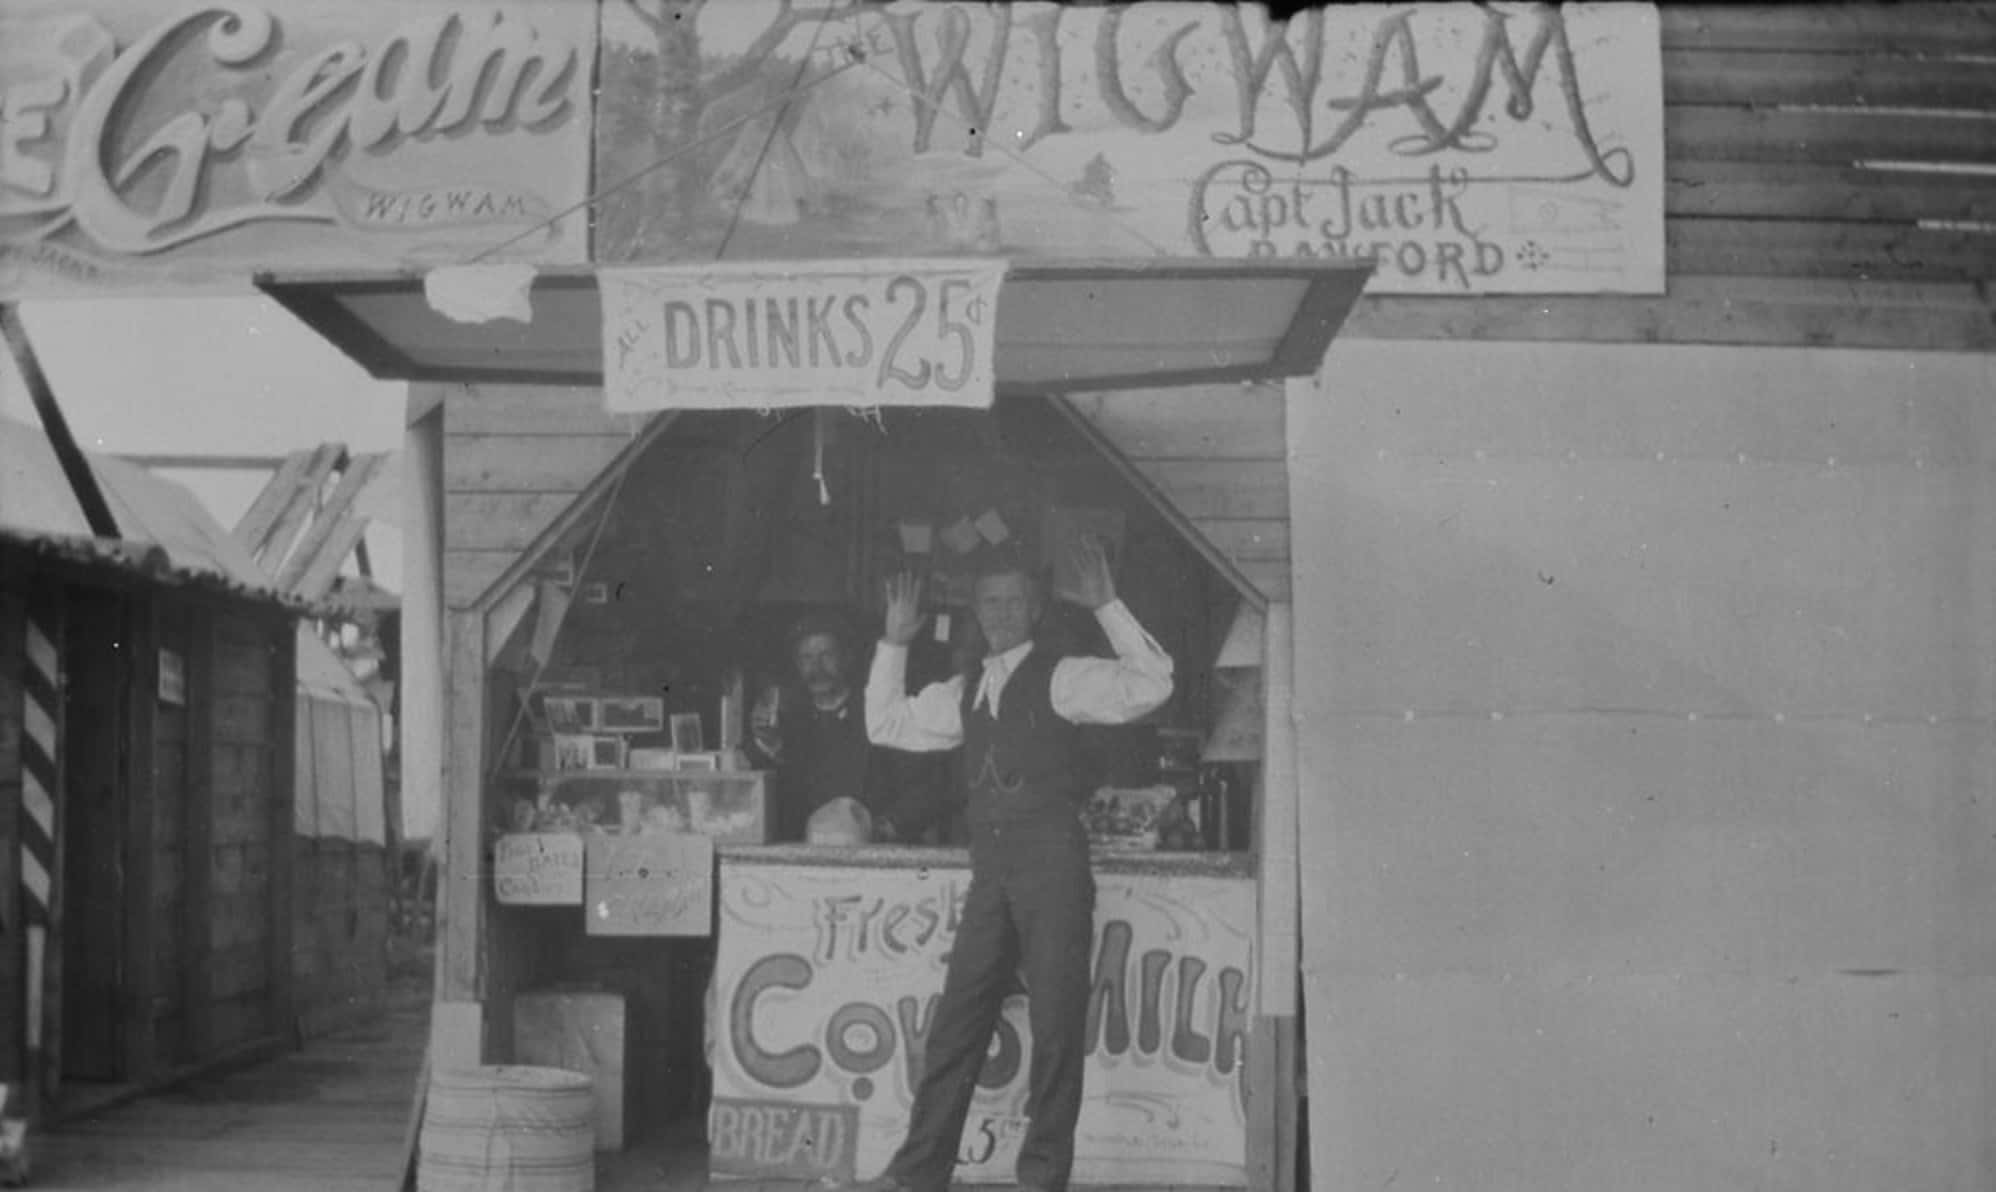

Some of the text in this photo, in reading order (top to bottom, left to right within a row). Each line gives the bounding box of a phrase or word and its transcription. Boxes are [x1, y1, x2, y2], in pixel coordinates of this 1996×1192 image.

[893, 0, 1634, 188] WIGWAM
[365, 193, 527, 221] WIGWAM
[1189, 160, 1482, 257] Capt Jack
[664, 294, 875, 370] DRINKS
[711, 1104, 846, 1169] BREAD
